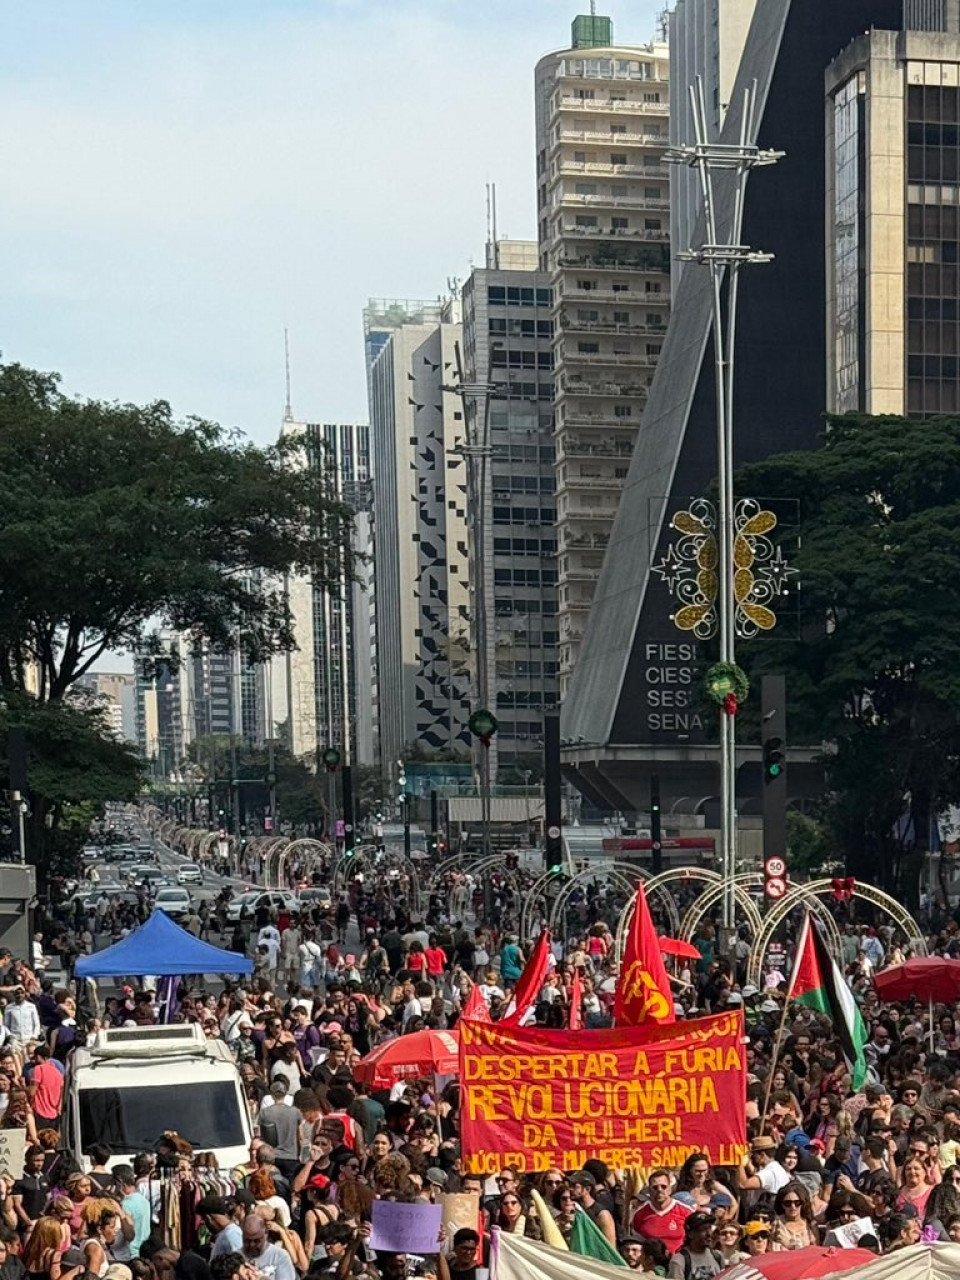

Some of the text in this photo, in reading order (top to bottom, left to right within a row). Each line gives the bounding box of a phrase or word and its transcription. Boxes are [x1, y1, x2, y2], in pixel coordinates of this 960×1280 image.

[769, 861, 783, 871] 50
[464, 1044, 742, 1081] DESPERTAR A FÚRIA
[468, 1071, 719, 1121] REVOLUCIONÁRIA
[523, 1117, 682, 1148] DA MULHER!
[532, 1150, 556, 1172] DE
